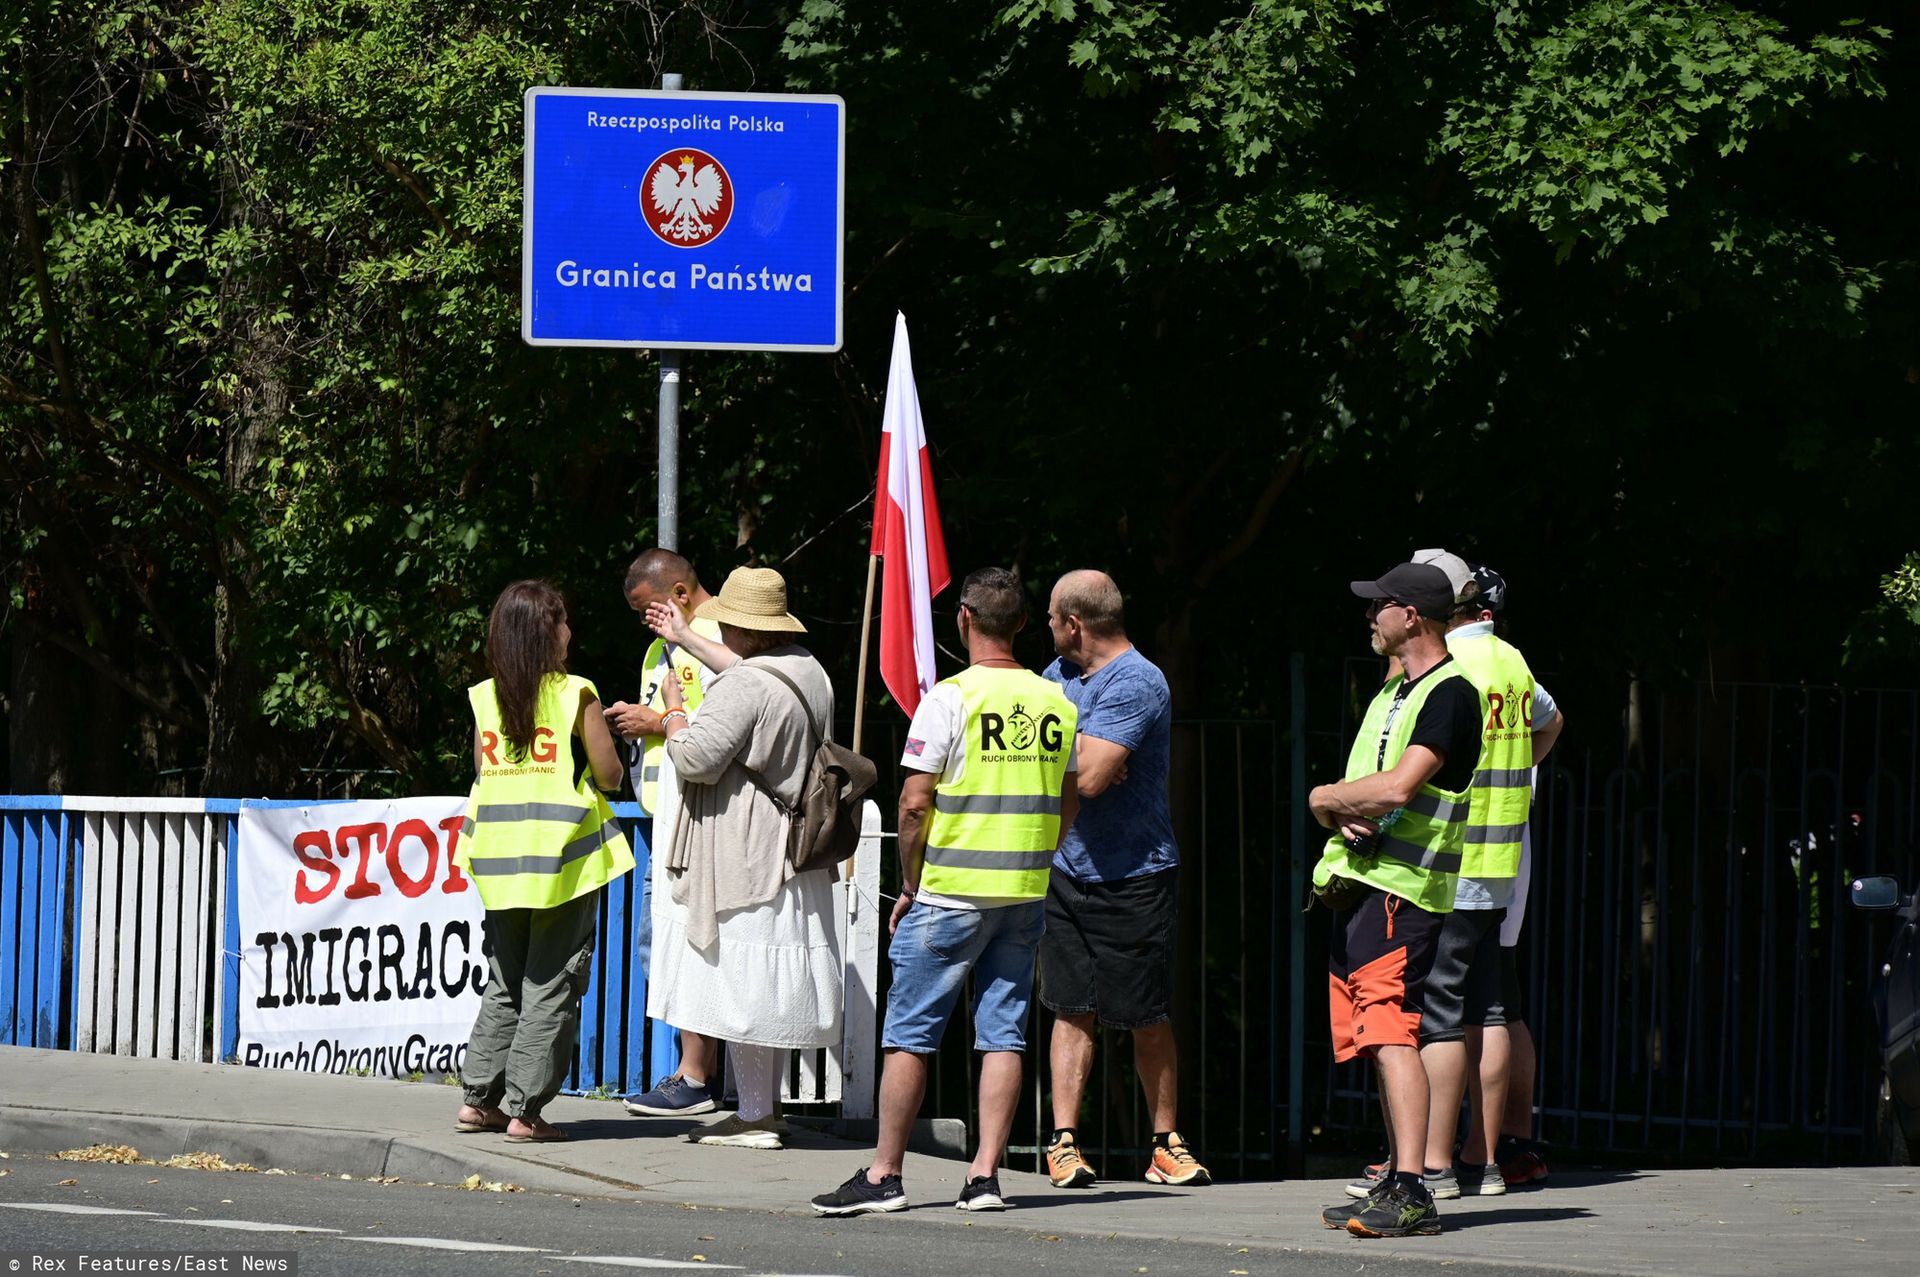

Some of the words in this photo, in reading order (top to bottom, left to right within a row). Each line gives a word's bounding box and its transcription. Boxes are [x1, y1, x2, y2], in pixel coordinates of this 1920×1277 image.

[587, 111, 721, 133] Rzeczpospolita
[729, 115, 785, 132] Polska
[555, 260, 676, 289] Granica
[690, 264, 812, 292] Państwa
[981, 755, 1005, 763] RUCH
[1007, 755, 1037, 763] OBRONY
[480, 769, 498, 777] UCH
[529, 766, 556, 775] RANIC
